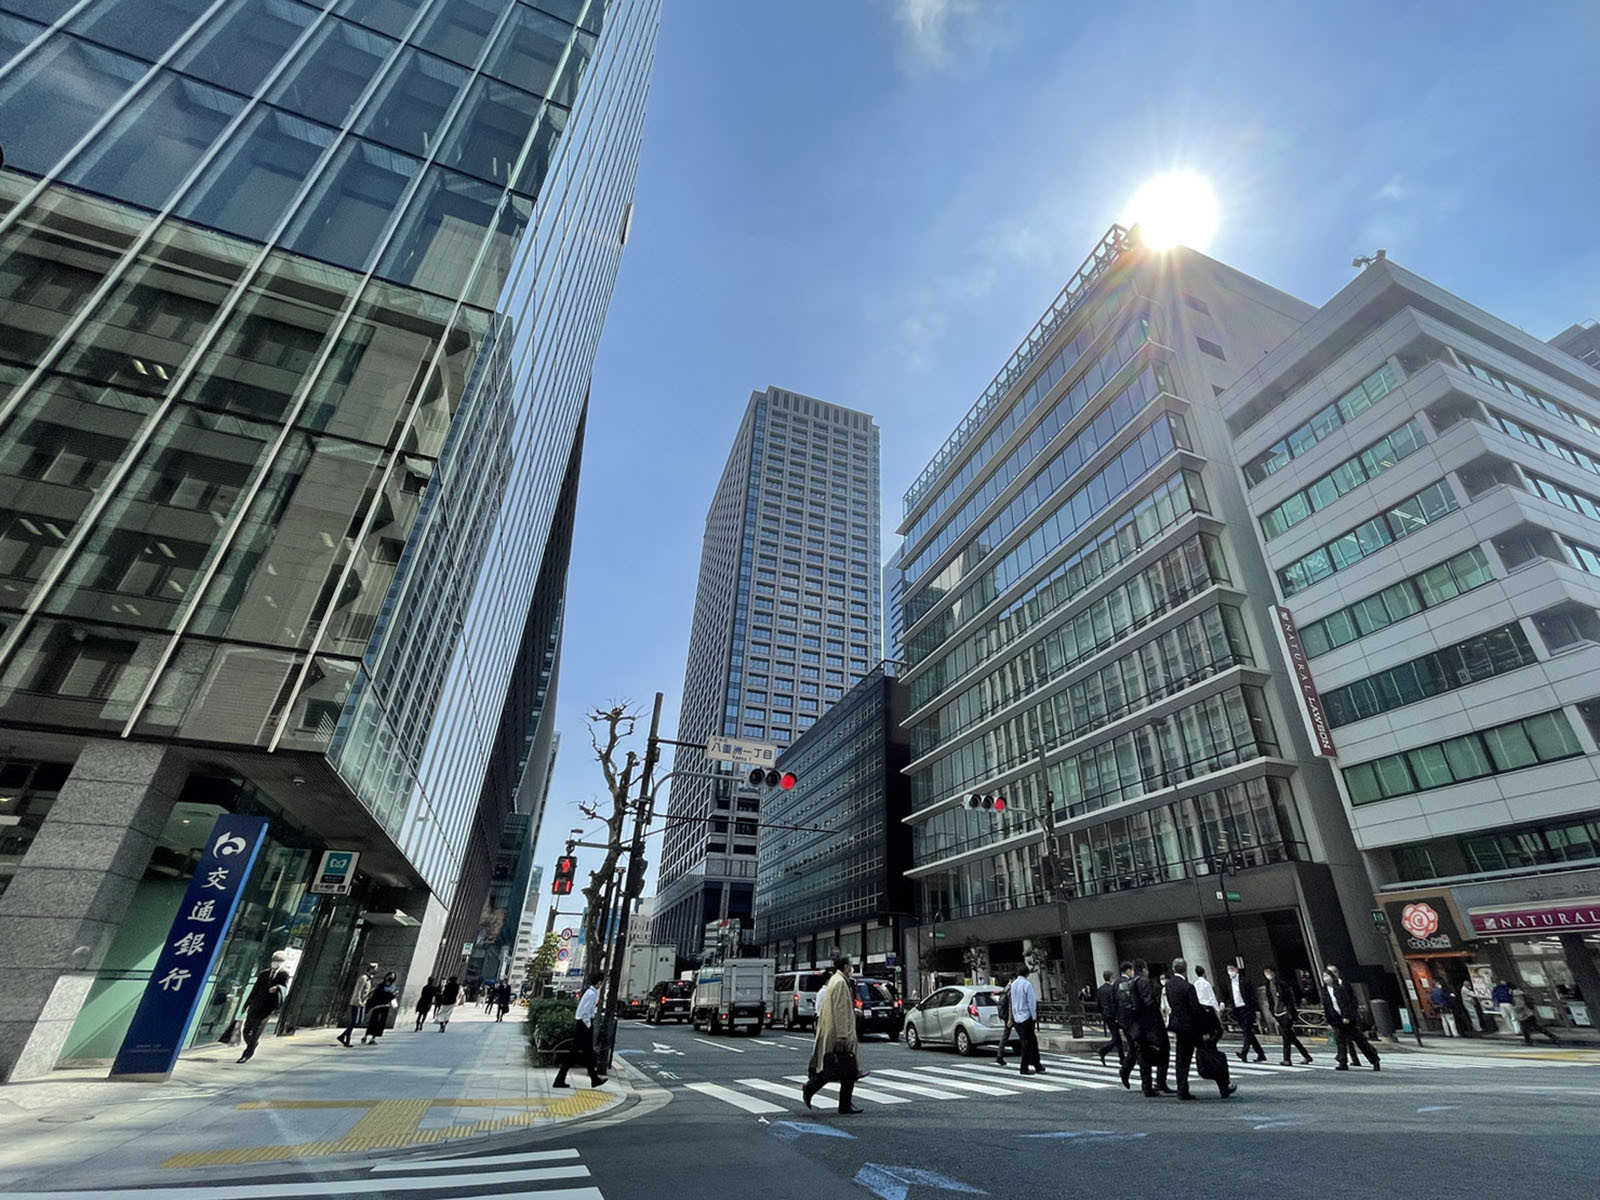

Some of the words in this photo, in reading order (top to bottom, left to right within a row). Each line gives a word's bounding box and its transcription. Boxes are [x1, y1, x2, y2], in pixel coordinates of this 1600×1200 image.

[1284, 623, 1312, 691] NATURAL
[1307, 696, 1331, 750] LAWSON
[158, 866, 230, 992] 交通銀行
[1500, 911, 1600, 928] NATURAL
